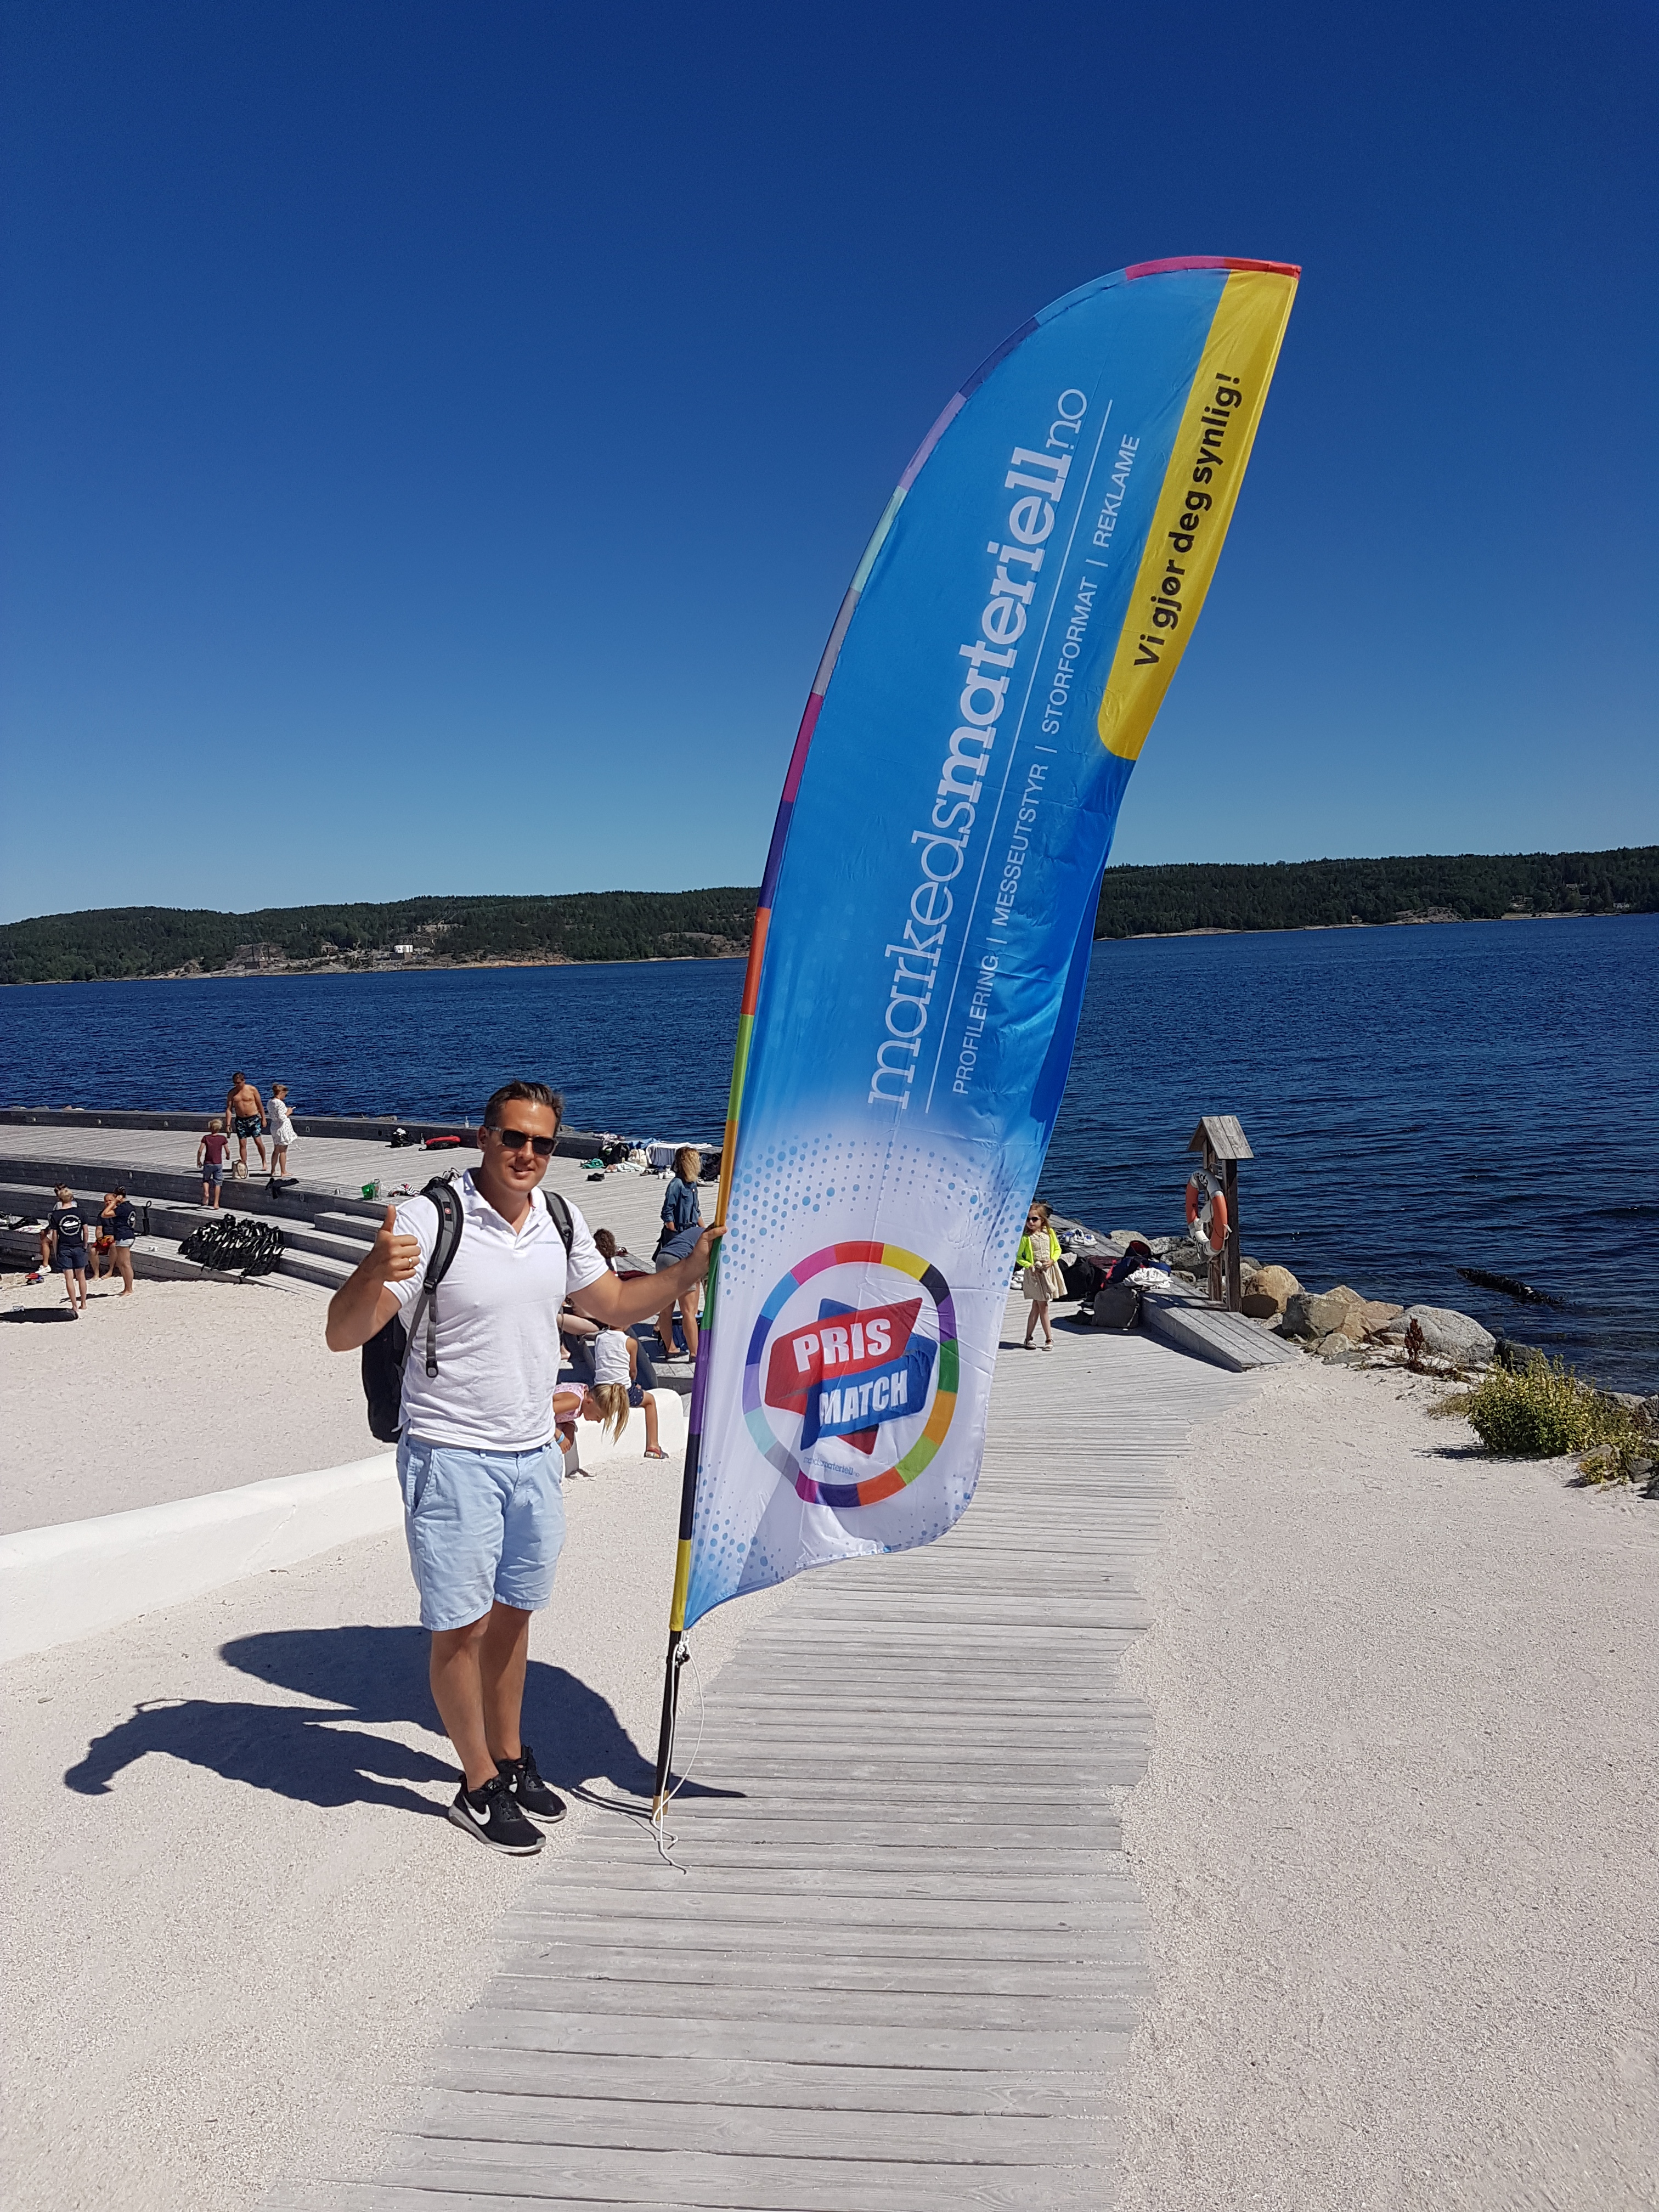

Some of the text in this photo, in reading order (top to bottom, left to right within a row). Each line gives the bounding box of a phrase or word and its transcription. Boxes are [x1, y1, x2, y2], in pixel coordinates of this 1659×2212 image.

[1133, 373, 1242, 666] Vi gjør deg synlig!
[868, 388, 1087, 1110] markedsmateriell.no
[952, 955, 1000, 1095] PROFILERING
[992, 763, 1048, 927] MESSEUTSTYR
[1042, 576, 1098, 735] STORFORMAT
[1093, 433, 1140, 548] REKLAME
[792, 1318, 891, 1373] PRIS
[819, 1369, 908, 1427] MATCH
